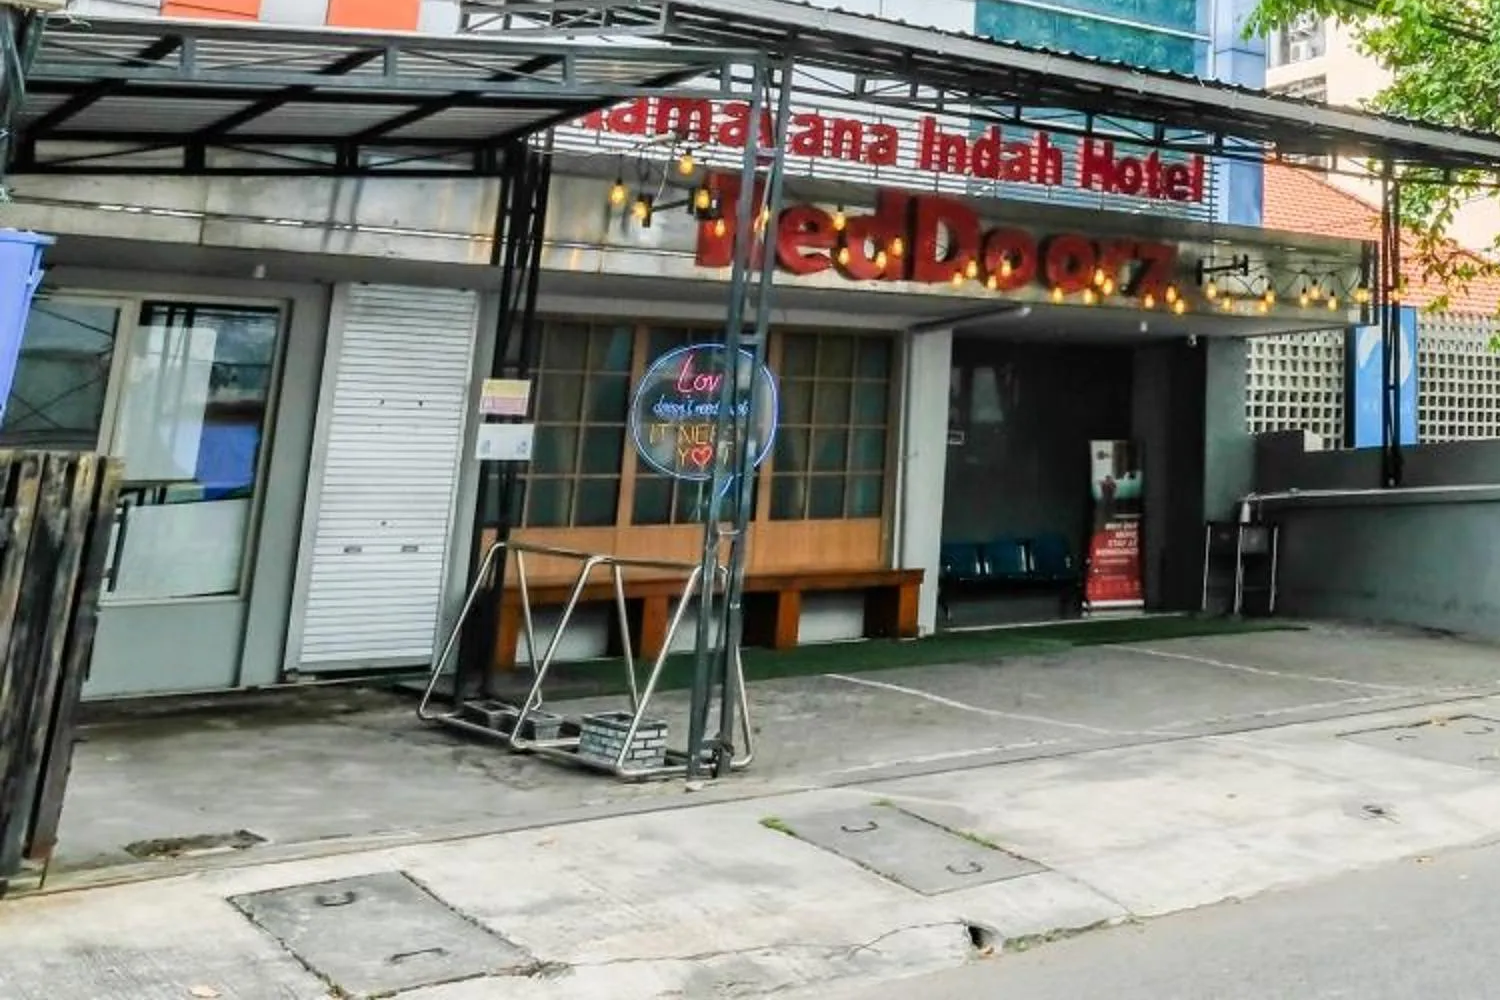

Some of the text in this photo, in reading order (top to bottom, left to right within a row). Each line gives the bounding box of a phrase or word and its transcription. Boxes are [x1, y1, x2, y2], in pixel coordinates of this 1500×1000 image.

[582, 96, 1206, 204] amaana Indah Hotel
